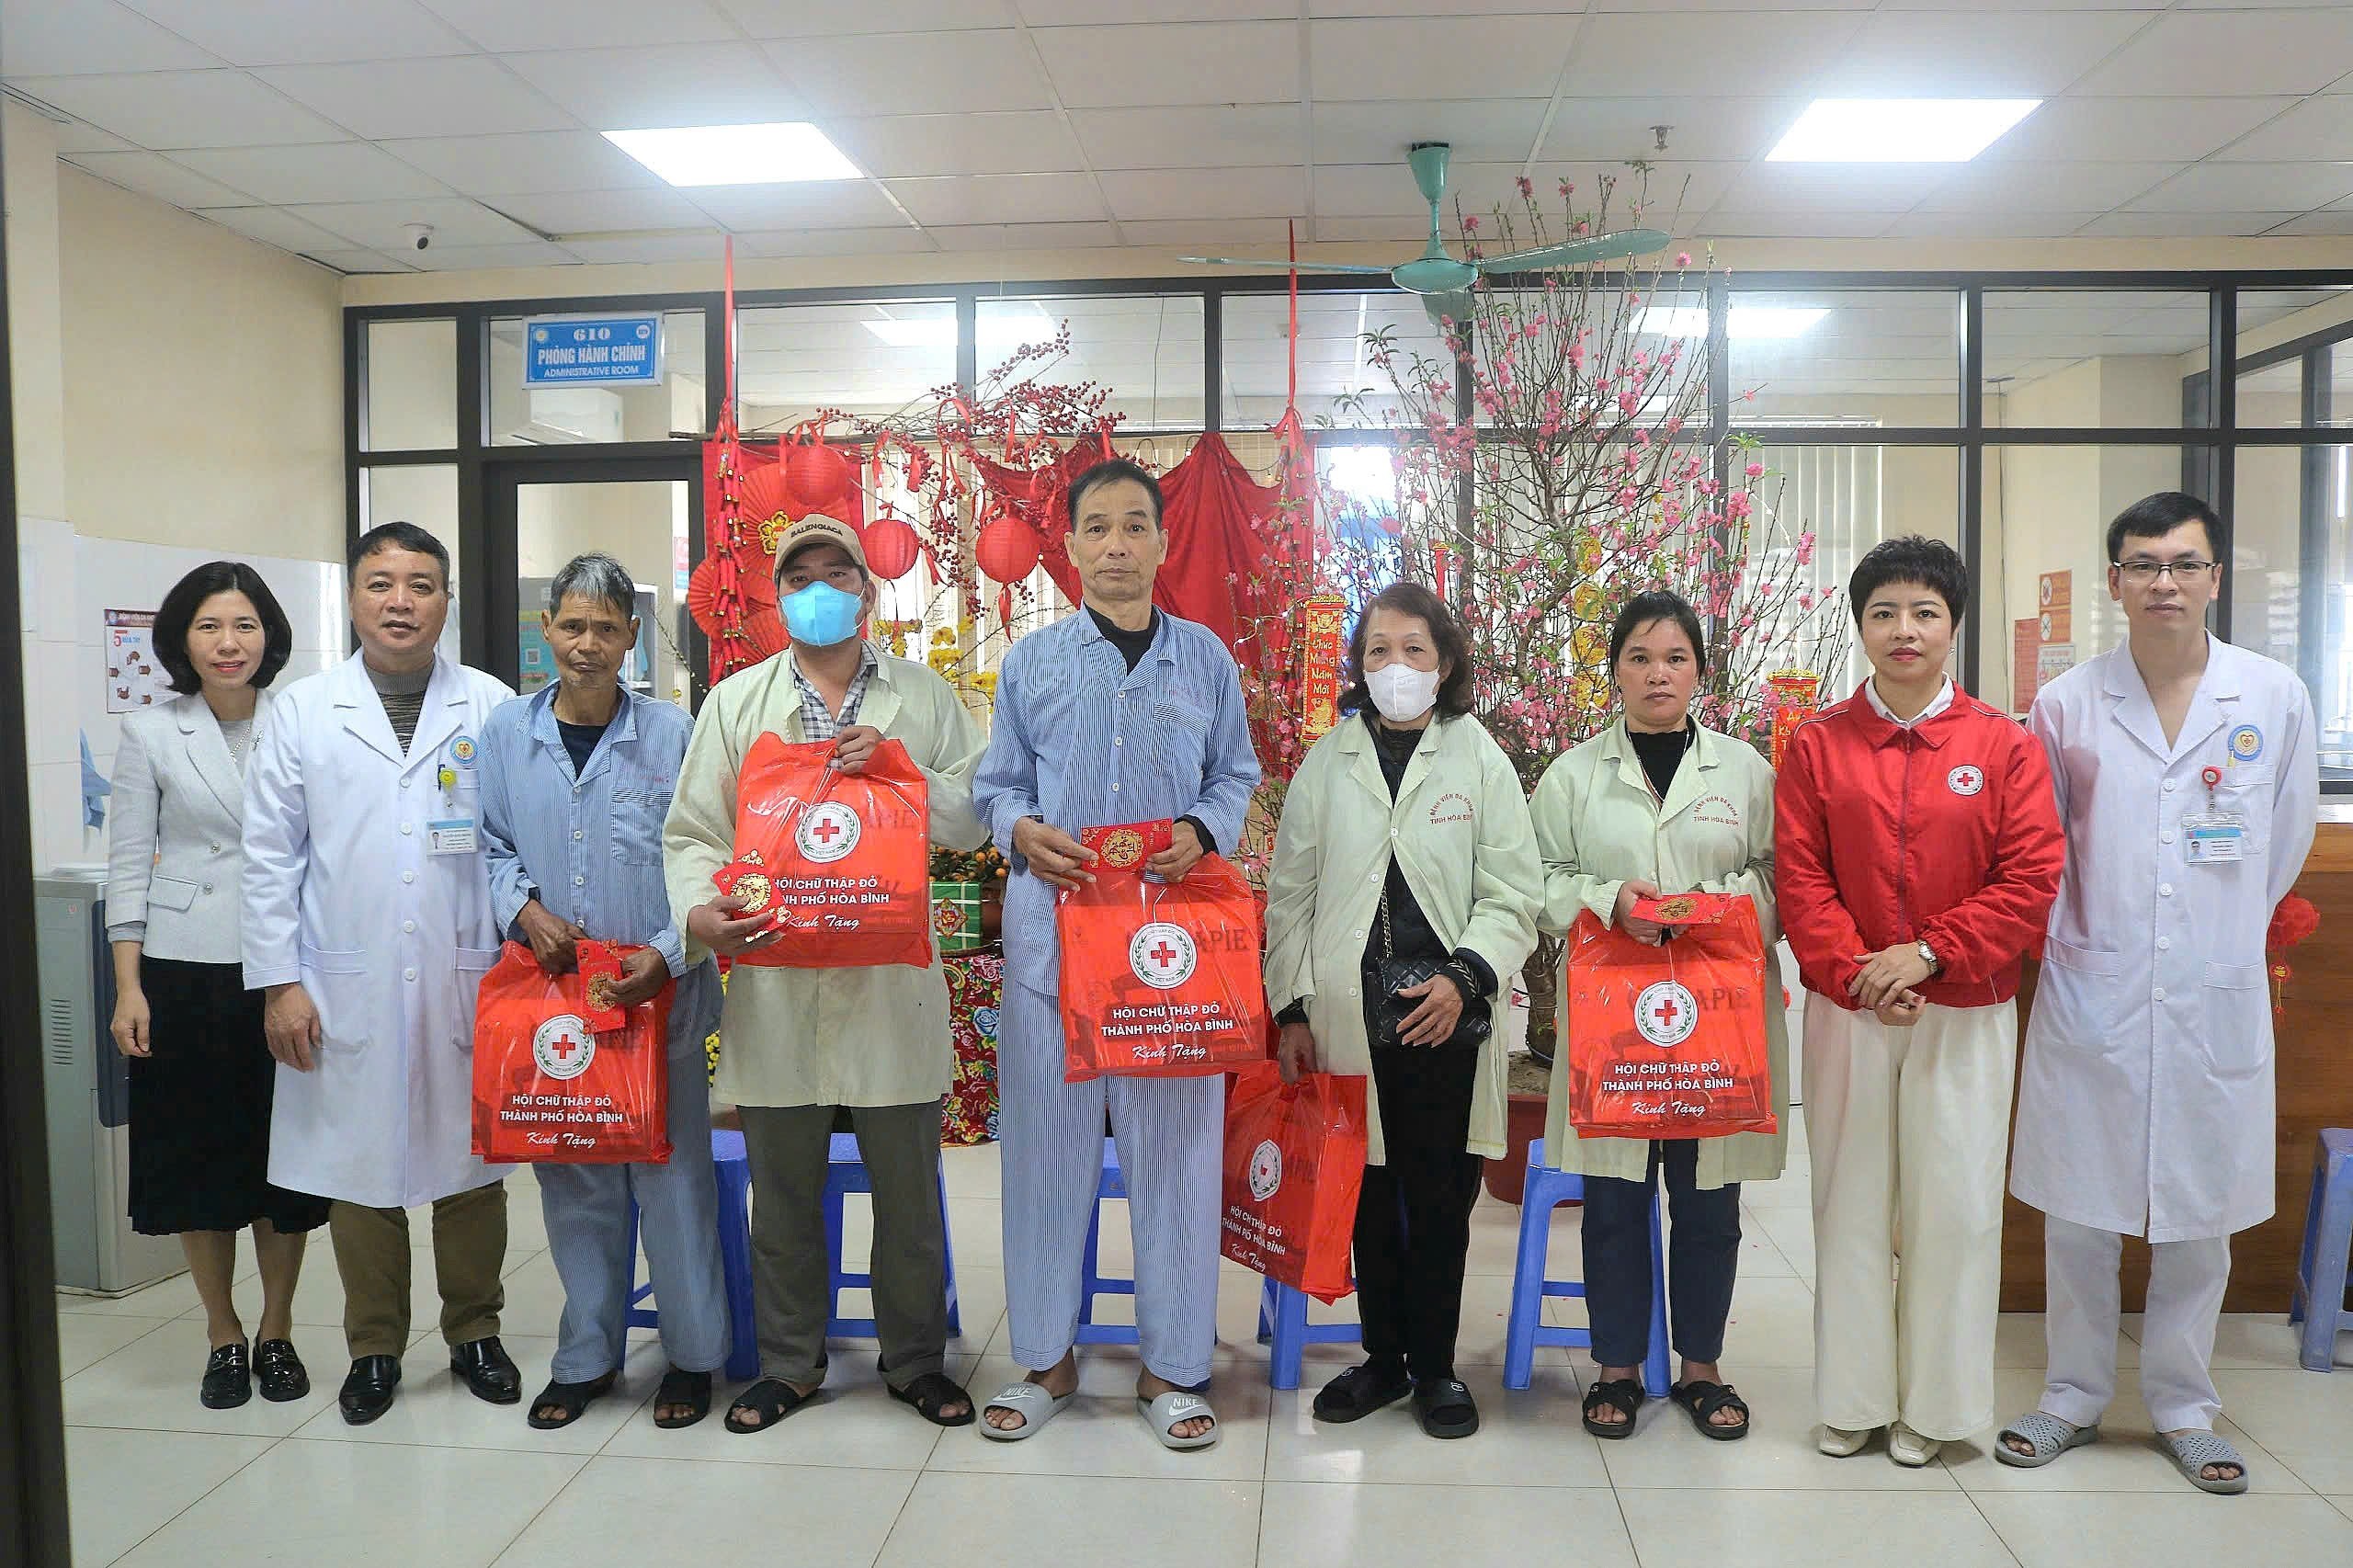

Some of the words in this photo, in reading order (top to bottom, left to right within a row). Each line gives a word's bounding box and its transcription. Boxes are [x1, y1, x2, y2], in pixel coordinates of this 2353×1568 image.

[573, 327, 611, 342] 610
[537, 347, 575, 365] PHÒNG
[578, 344, 608, 363] HÀNH
[611, 342, 646, 362] CHÍNH
[543, 366, 610, 379] ADMINISTRATIVE
[611, 365, 640, 376] ROOM
[795, 877, 822, 890] CHỮ
[824, 876, 855, 891] THẬP
[858, 874, 878, 889] ĐỎ
[801, 891, 826, 905] PHỐ
[829, 891, 857, 904] HÒA
[860, 891, 890, 903] BÌNH
[1112, 1006, 1136, 1021] HỘI
[1139, 1004, 1166, 1018] CHỮ
[1168, 1003, 1199, 1017] THẬP
[1201, 1000, 1221, 1015] ĐỎ
[1101, 1023, 1142, 1037] THÀNH
[1146, 1019, 1172, 1034] PHỐ
[1175, 1019, 1200, 1032] HÒA
[1205, 1018, 1233, 1031] BÌNH
[1172, 1043, 1207, 1060] Tặng
[1614, 1062, 1637, 1077] HỘI
[1640, 1062, 1666, 1074] CHỮ
[1668, 1062, 1698, 1075] THẬP
[1701, 1058, 1721, 1073] ĐỎ
[1602, 1079, 1643, 1092] THÀNH
[1646, 1076, 1672, 1091] PHỐ
[1675, 1077, 1701, 1090] HÒA
[1704, 1075, 1733, 1090] BÌNH
[512, 1094, 533, 1108] HỘI
[536, 1093, 561, 1107] CHỮ
[563, 1093, 591, 1108] THẬP
[594, 1093, 612, 1108] ĐỎ
[499, 1109, 538, 1122] THÀNH
[540, 1108, 564, 1123] PHỐ
[567, 1110, 593, 1123] HÒA
[596, 1110, 623, 1124] BÌNH
[1671, 1101, 1707, 1117] Tặng
[562, 1132, 597, 1149] Tặng
[1267, 1224, 1282, 1237] ĐỎ
[1267, 1240, 1286, 1256] BÌNH
[1003, 1386, 1031, 1397] NIKE
[1173, 1397, 1199, 1408] NIKE
